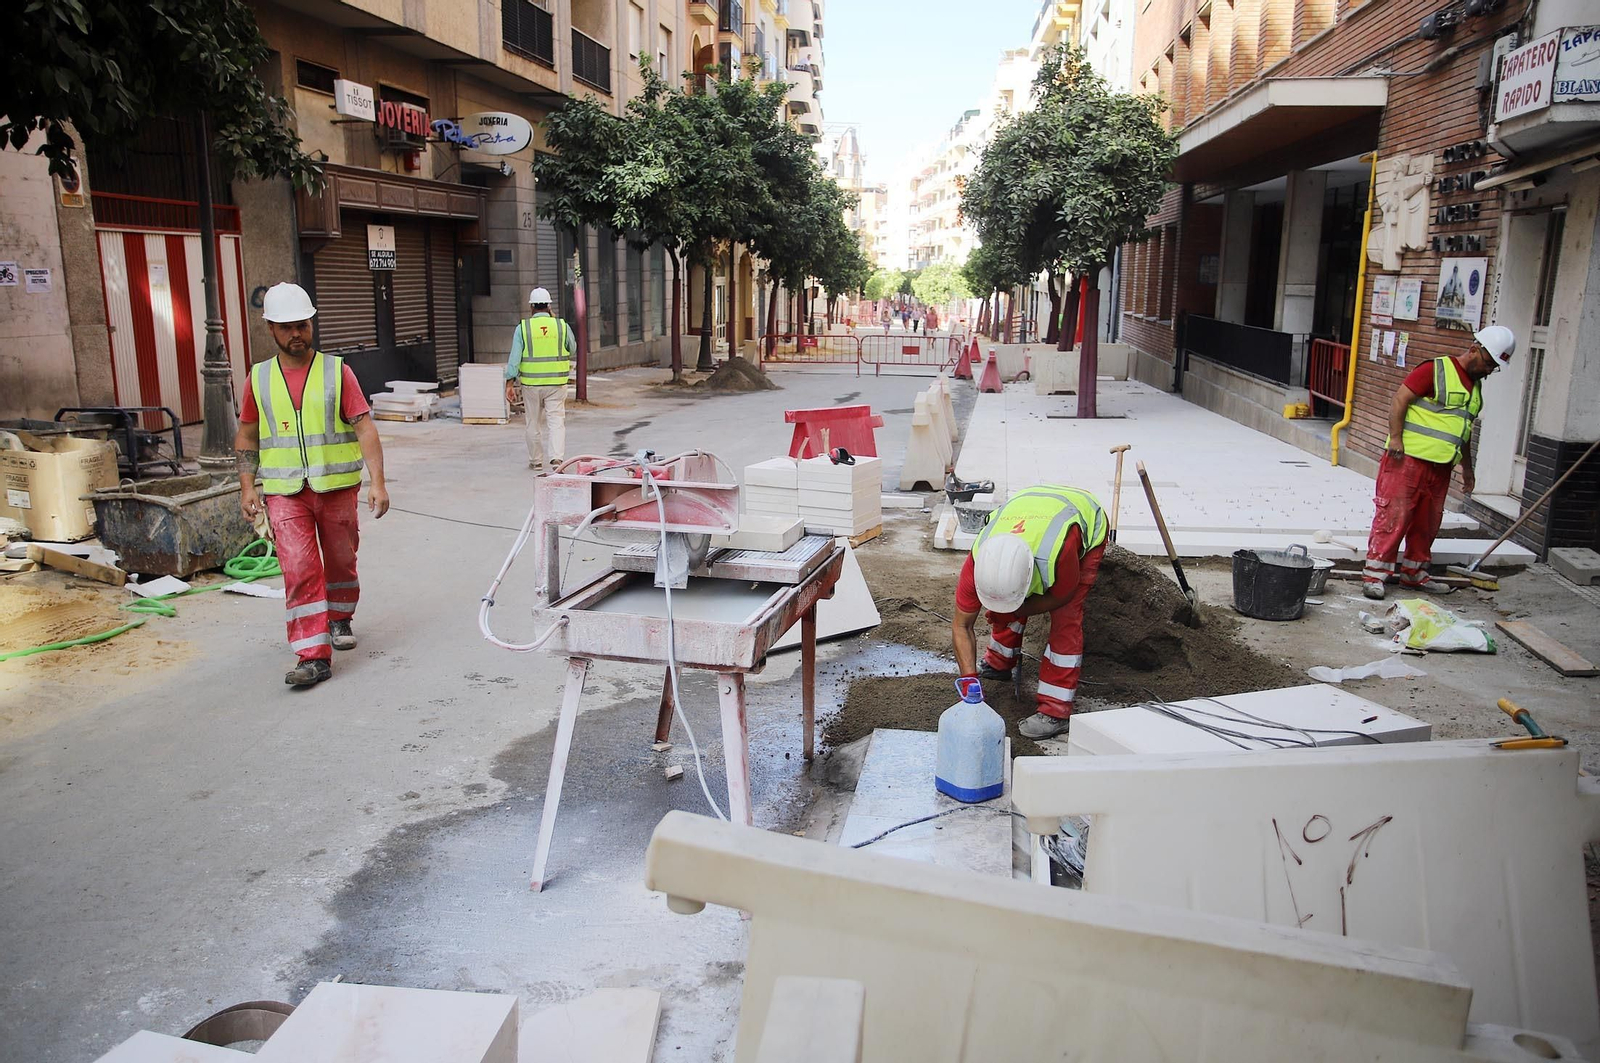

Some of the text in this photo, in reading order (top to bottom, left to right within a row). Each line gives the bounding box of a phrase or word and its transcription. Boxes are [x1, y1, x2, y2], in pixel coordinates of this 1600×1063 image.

[1501, 39, 1556, 82] ZAPATERO
[346, 94, 372, 109] TISSOT
[1502, 80, 1542, 114] RAPIDO
[378, 99, 432, 138] JOYERIA
[478, 116, 508, 127] JOYERIA
[522, 211, 532, 229] 25
[5, 474, 28, 483] FRAGILE
